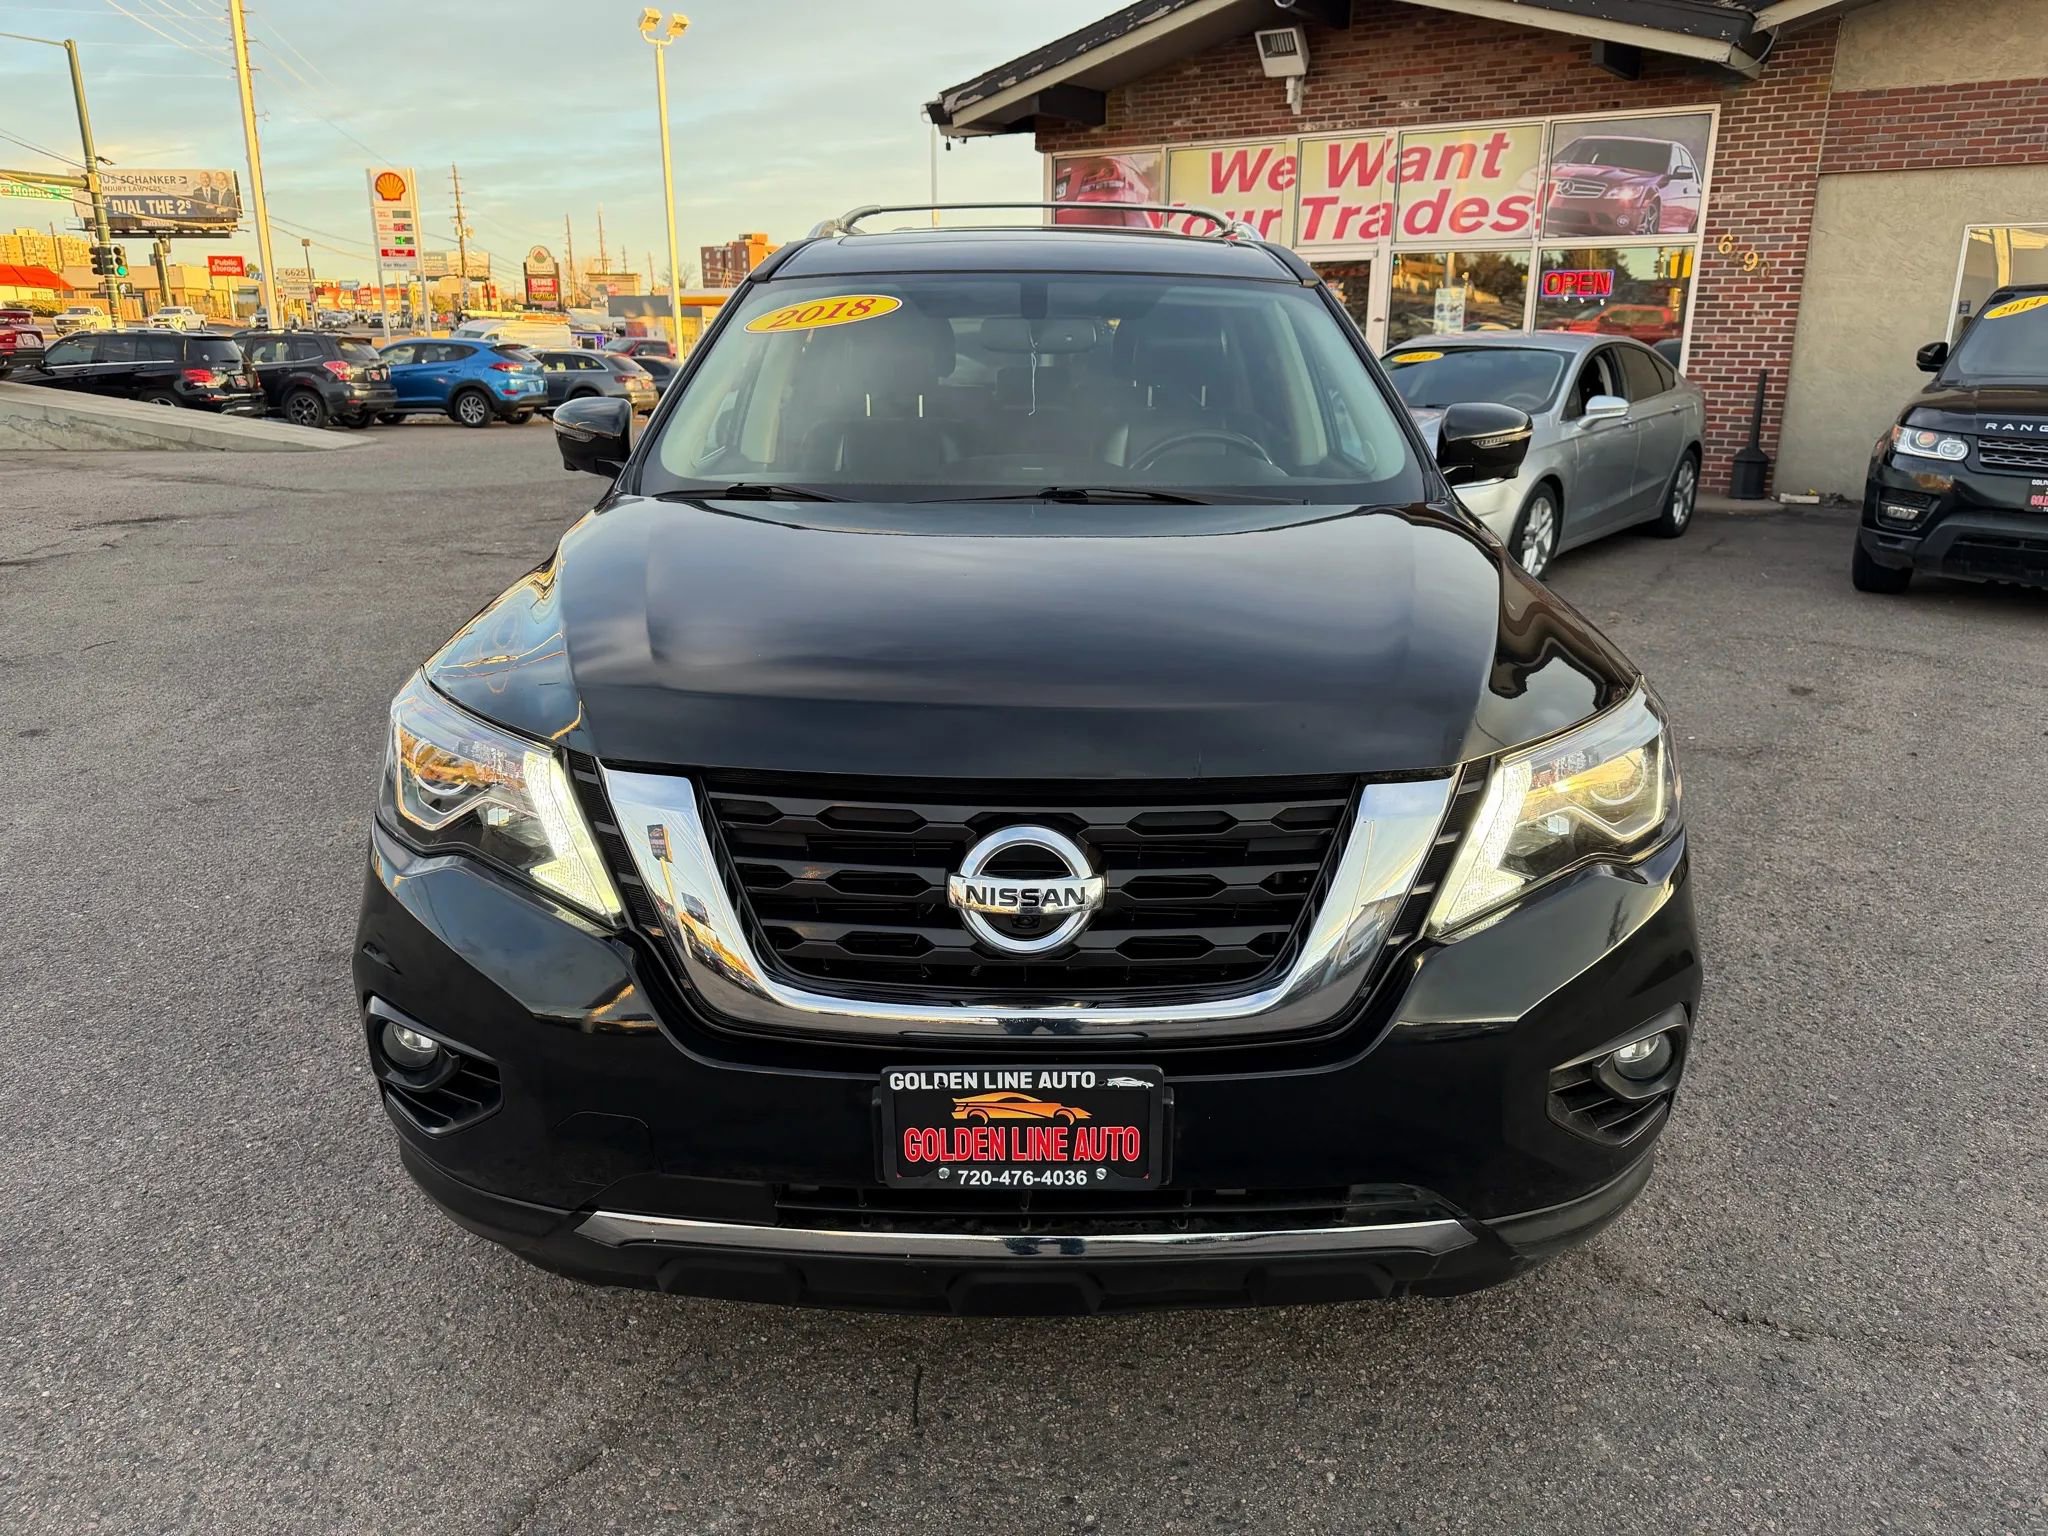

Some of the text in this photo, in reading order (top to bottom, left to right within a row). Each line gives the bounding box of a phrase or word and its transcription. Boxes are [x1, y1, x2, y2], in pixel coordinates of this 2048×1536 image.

[1210, 132, 1512, 194] We Want
[102, 185, 127, 193] INJURY
[120, 175, 177, 185] SCHANKER
[112, 200, 145, 215] DIAL
[146, 200, 175, 215] THE
[1301, 182, 1556, 241] Trades!
[211, 265, 241, 274] Storage
[214, 259, 238, 267] Public
[285, 268, 306, 277] 6625
[1544, 271, 1611, 296] OPEN
[766, 298, 877, 330] 2018
[1997, 297, 2042, 316] 2014
[965, 885, 1086, 907] NISSAN
[889, 1071, 1096, 1091] GOLDEN LINE AUTO
[904, 1126, 1141, 1162] GOLDEN LINE AUTO
[958, 1169, 1088, 1186] 720-476-4036
